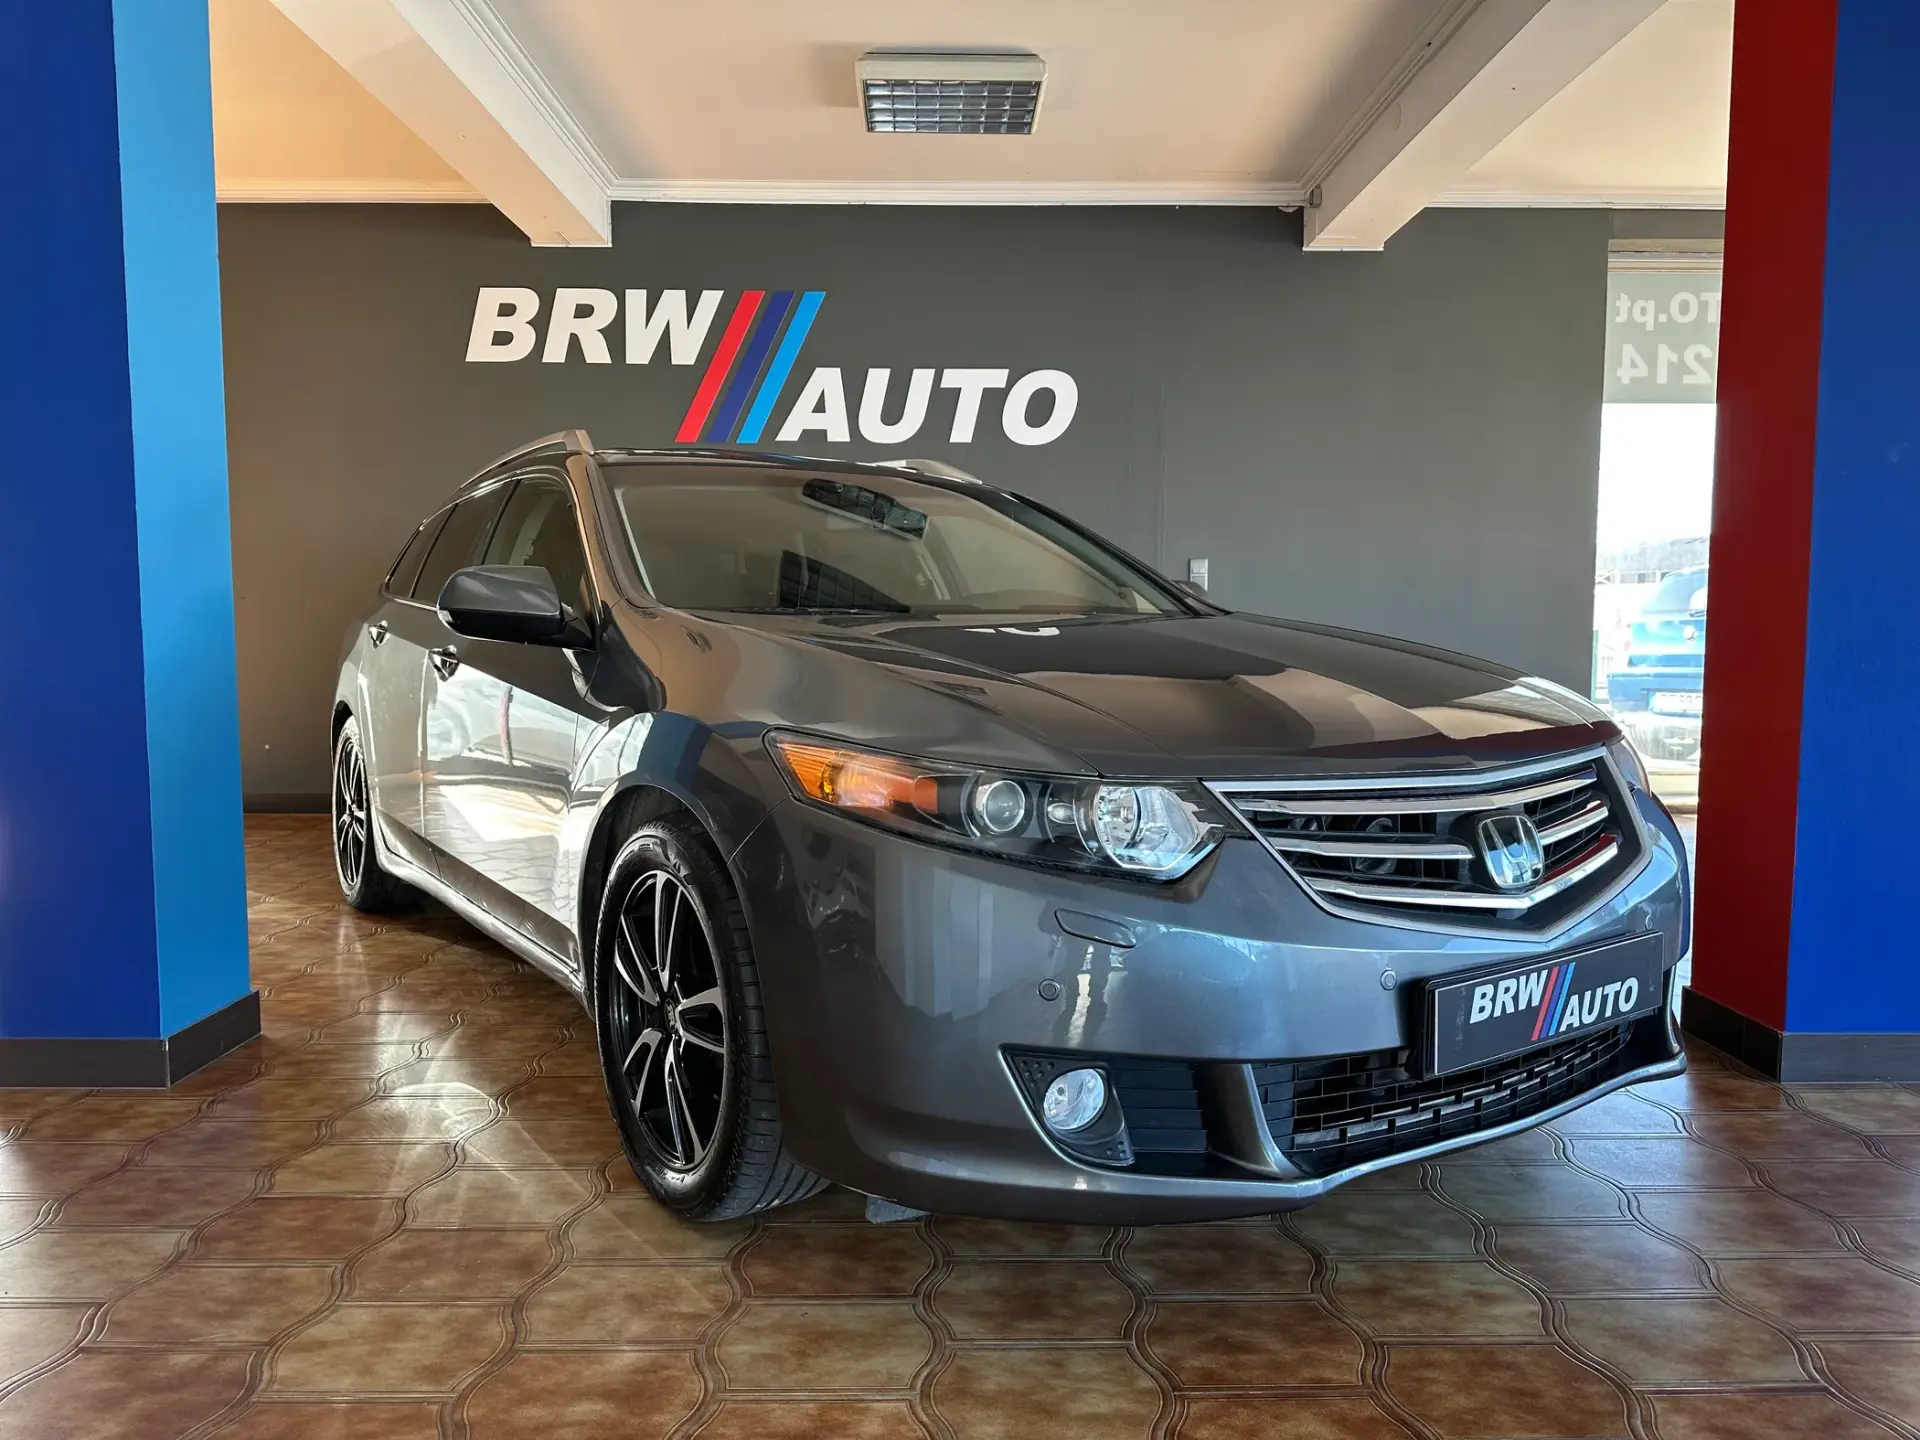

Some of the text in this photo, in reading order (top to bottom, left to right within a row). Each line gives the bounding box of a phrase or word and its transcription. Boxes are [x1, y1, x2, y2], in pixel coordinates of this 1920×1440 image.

[465, 287, 724, 365] BRW
[775, 366, 1079, 446] AUTO
[1469, 969, 1549, 1024] BRW
[1559, 976, 1639, 1032] AUTO
